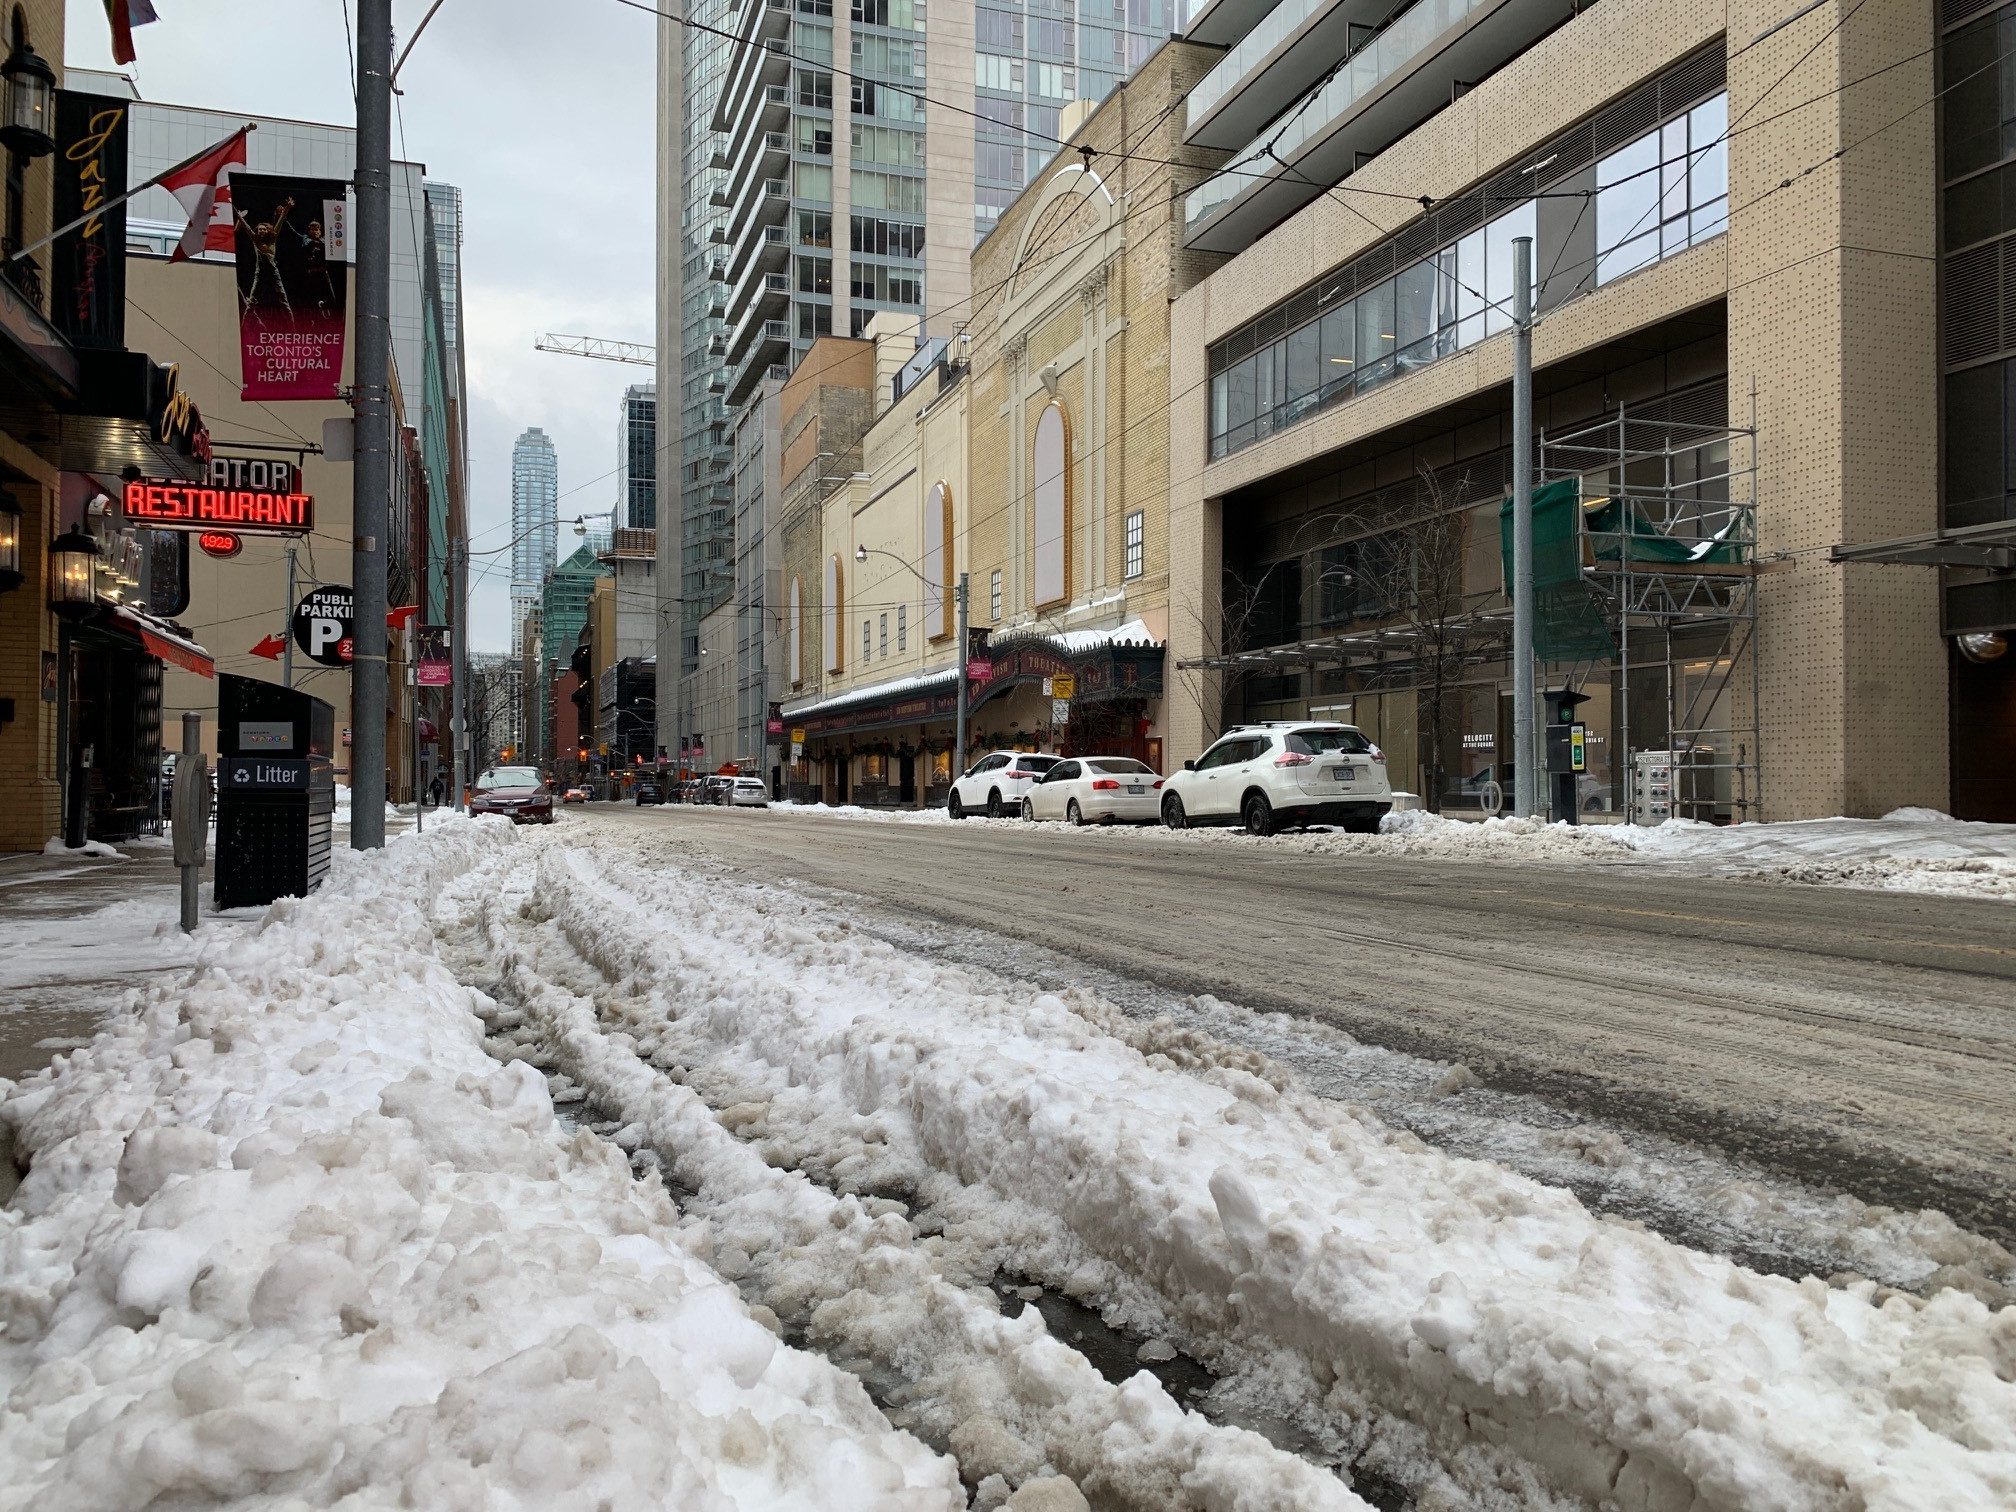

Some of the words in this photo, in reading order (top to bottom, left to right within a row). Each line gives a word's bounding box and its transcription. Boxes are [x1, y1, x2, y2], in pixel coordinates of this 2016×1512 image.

[65, 108, 123, 238] Jazz
[260, 333, 340, 344] EXPERIENCE
[247, 345, 322, 357] TORONTO'S
[266, 359, 330, 369] CULTURAL
[258, 371, 298, 382] HEART
[127, 484, 309, 524] RESTAURANT
[202, 534, 234, 550] 1929
[312, 594, 353, 606] PUBLI
[301, 604, 353, 618] PARKI
[1463, 734, 1493, 742] VELOCITY
[256, 765, 298, 783] Litter
